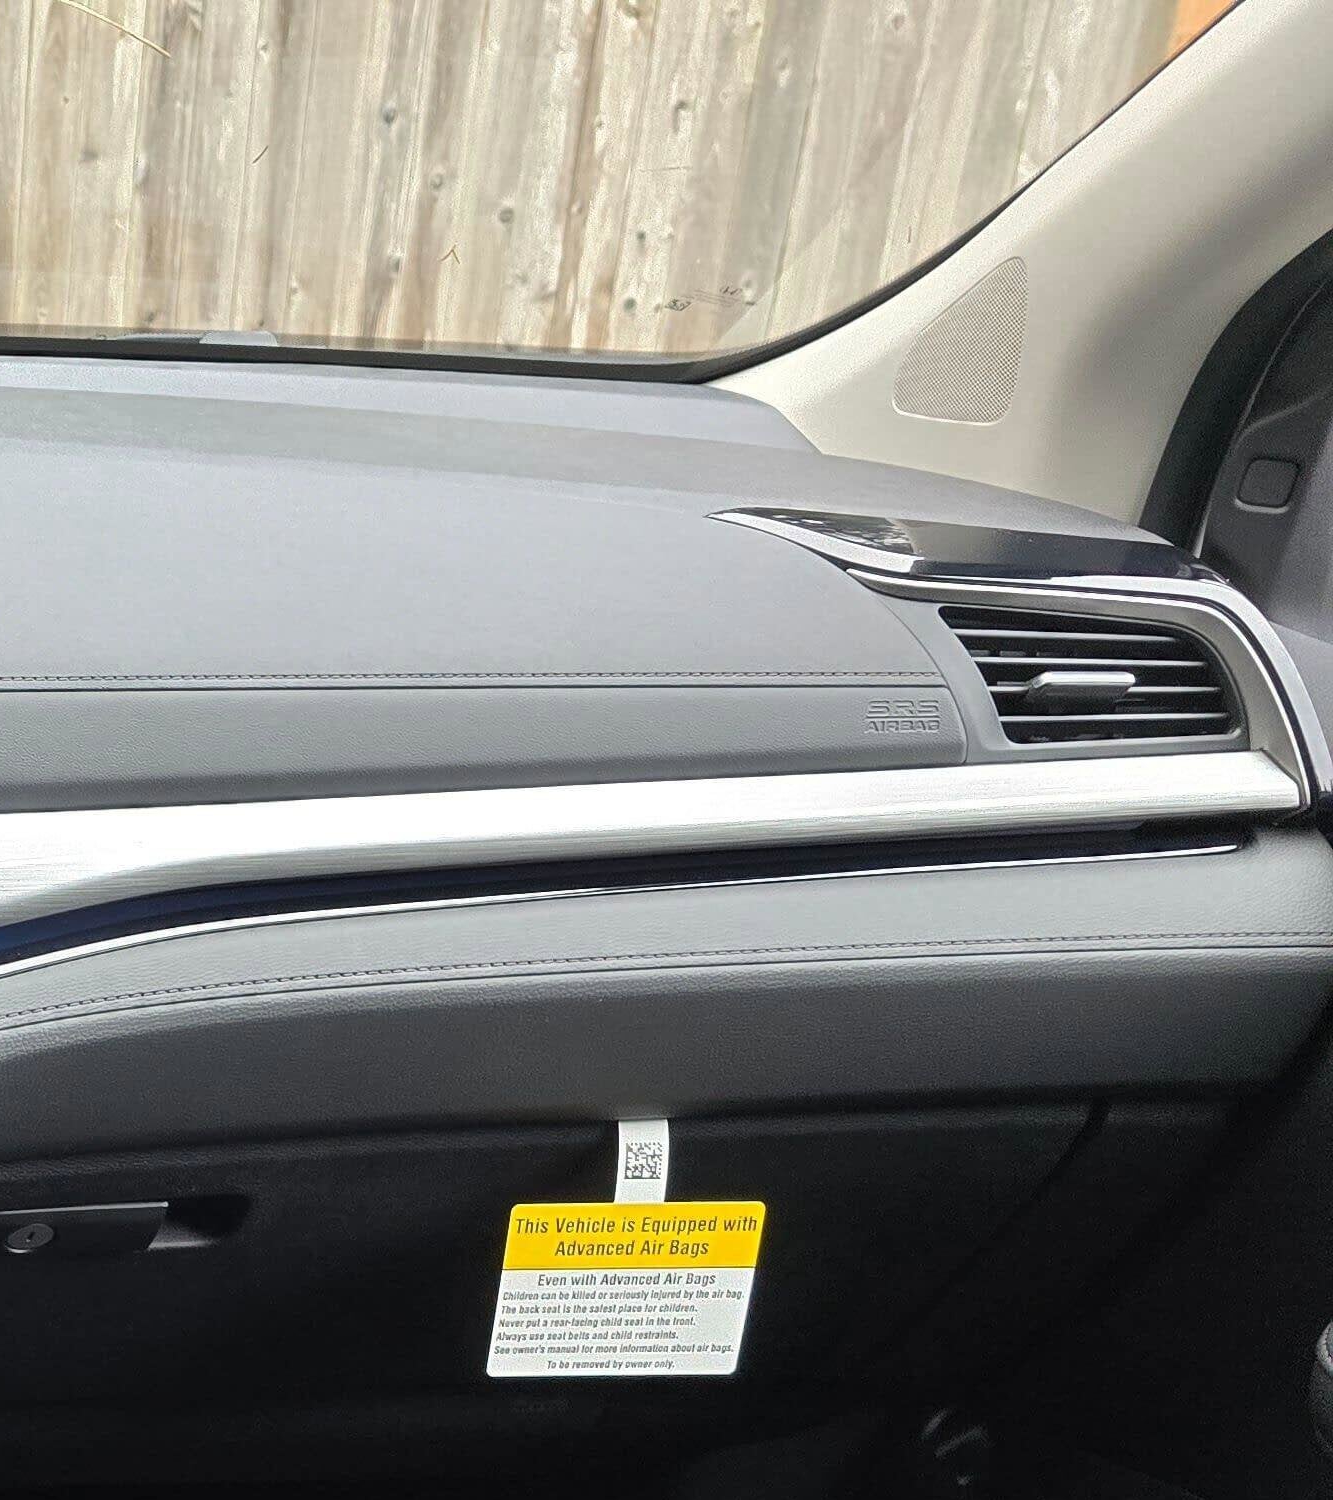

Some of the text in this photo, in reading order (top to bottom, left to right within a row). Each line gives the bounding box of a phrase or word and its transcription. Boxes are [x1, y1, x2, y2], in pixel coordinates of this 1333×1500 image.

[866, 700, 940, 717] SRS
[864, 719, 941, 734] AIRBAG
[516, 1215, 758, 1236] This Vehicle is Equipped with
[554, 1239, 710, 1258] Advanced Air Bags
[537, 1272, 716, 1287] Even with Advanced Air Bags
[502, 1289, 745, 1301] Children can be killed or seriously injured by the air bag.
[501, 1303, 698, 1315] The back seat is the safest place for children.
[496, 1330, 679, 1342] Always use seat belts and child restraints.
[547, 1360, 557, 1369] To
[558, 1360, 570, 1369] be
[572, 1359, 611, 1369] removed
[612, 1359, 624, 1370] by
[625, 1361, 653, 1369] owner
